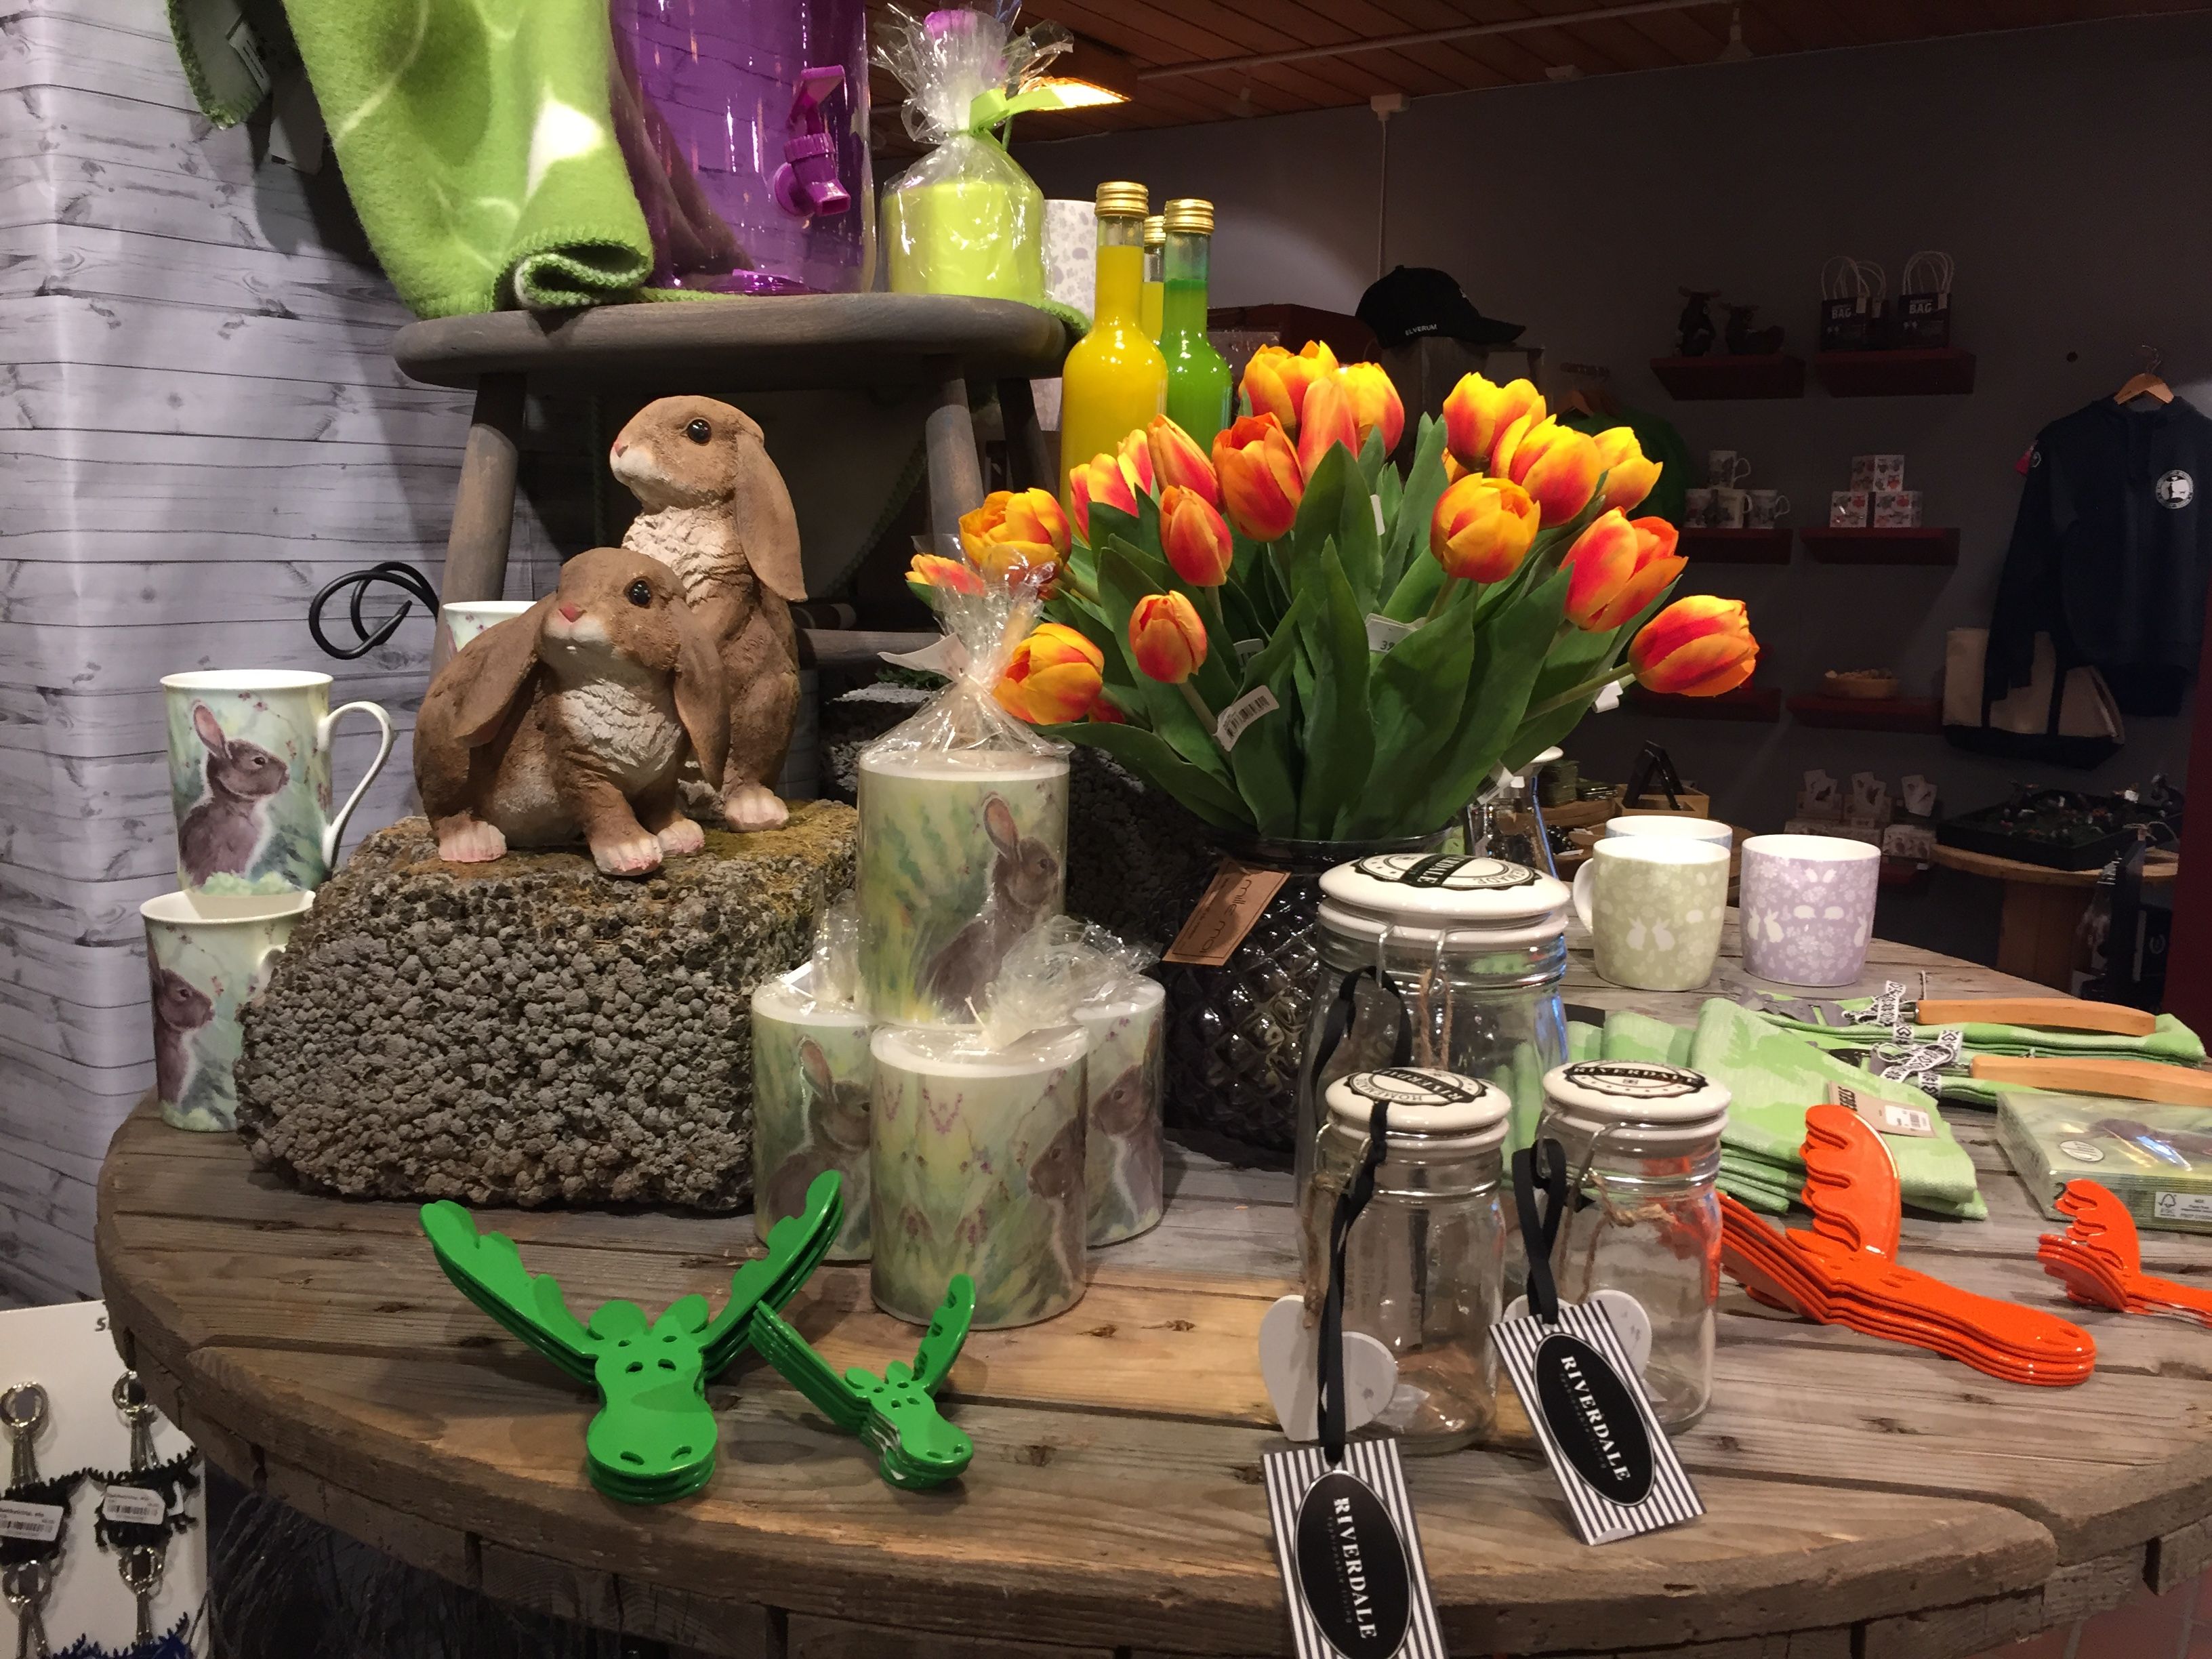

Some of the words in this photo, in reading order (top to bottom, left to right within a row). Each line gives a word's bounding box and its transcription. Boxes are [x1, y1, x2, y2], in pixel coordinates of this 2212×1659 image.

[1405, 324, 1437, 335] ELVERUM
[1224, 880, 1252, 915] mille
[1200, 920, 1225, 953] moi
[1574, 1067, 1699, 1084] RIVERDALE
[1561, 1355, 1631, 1481] RIVERDALE
[1334, 1497, 1377, 1639] RIVERDALE
